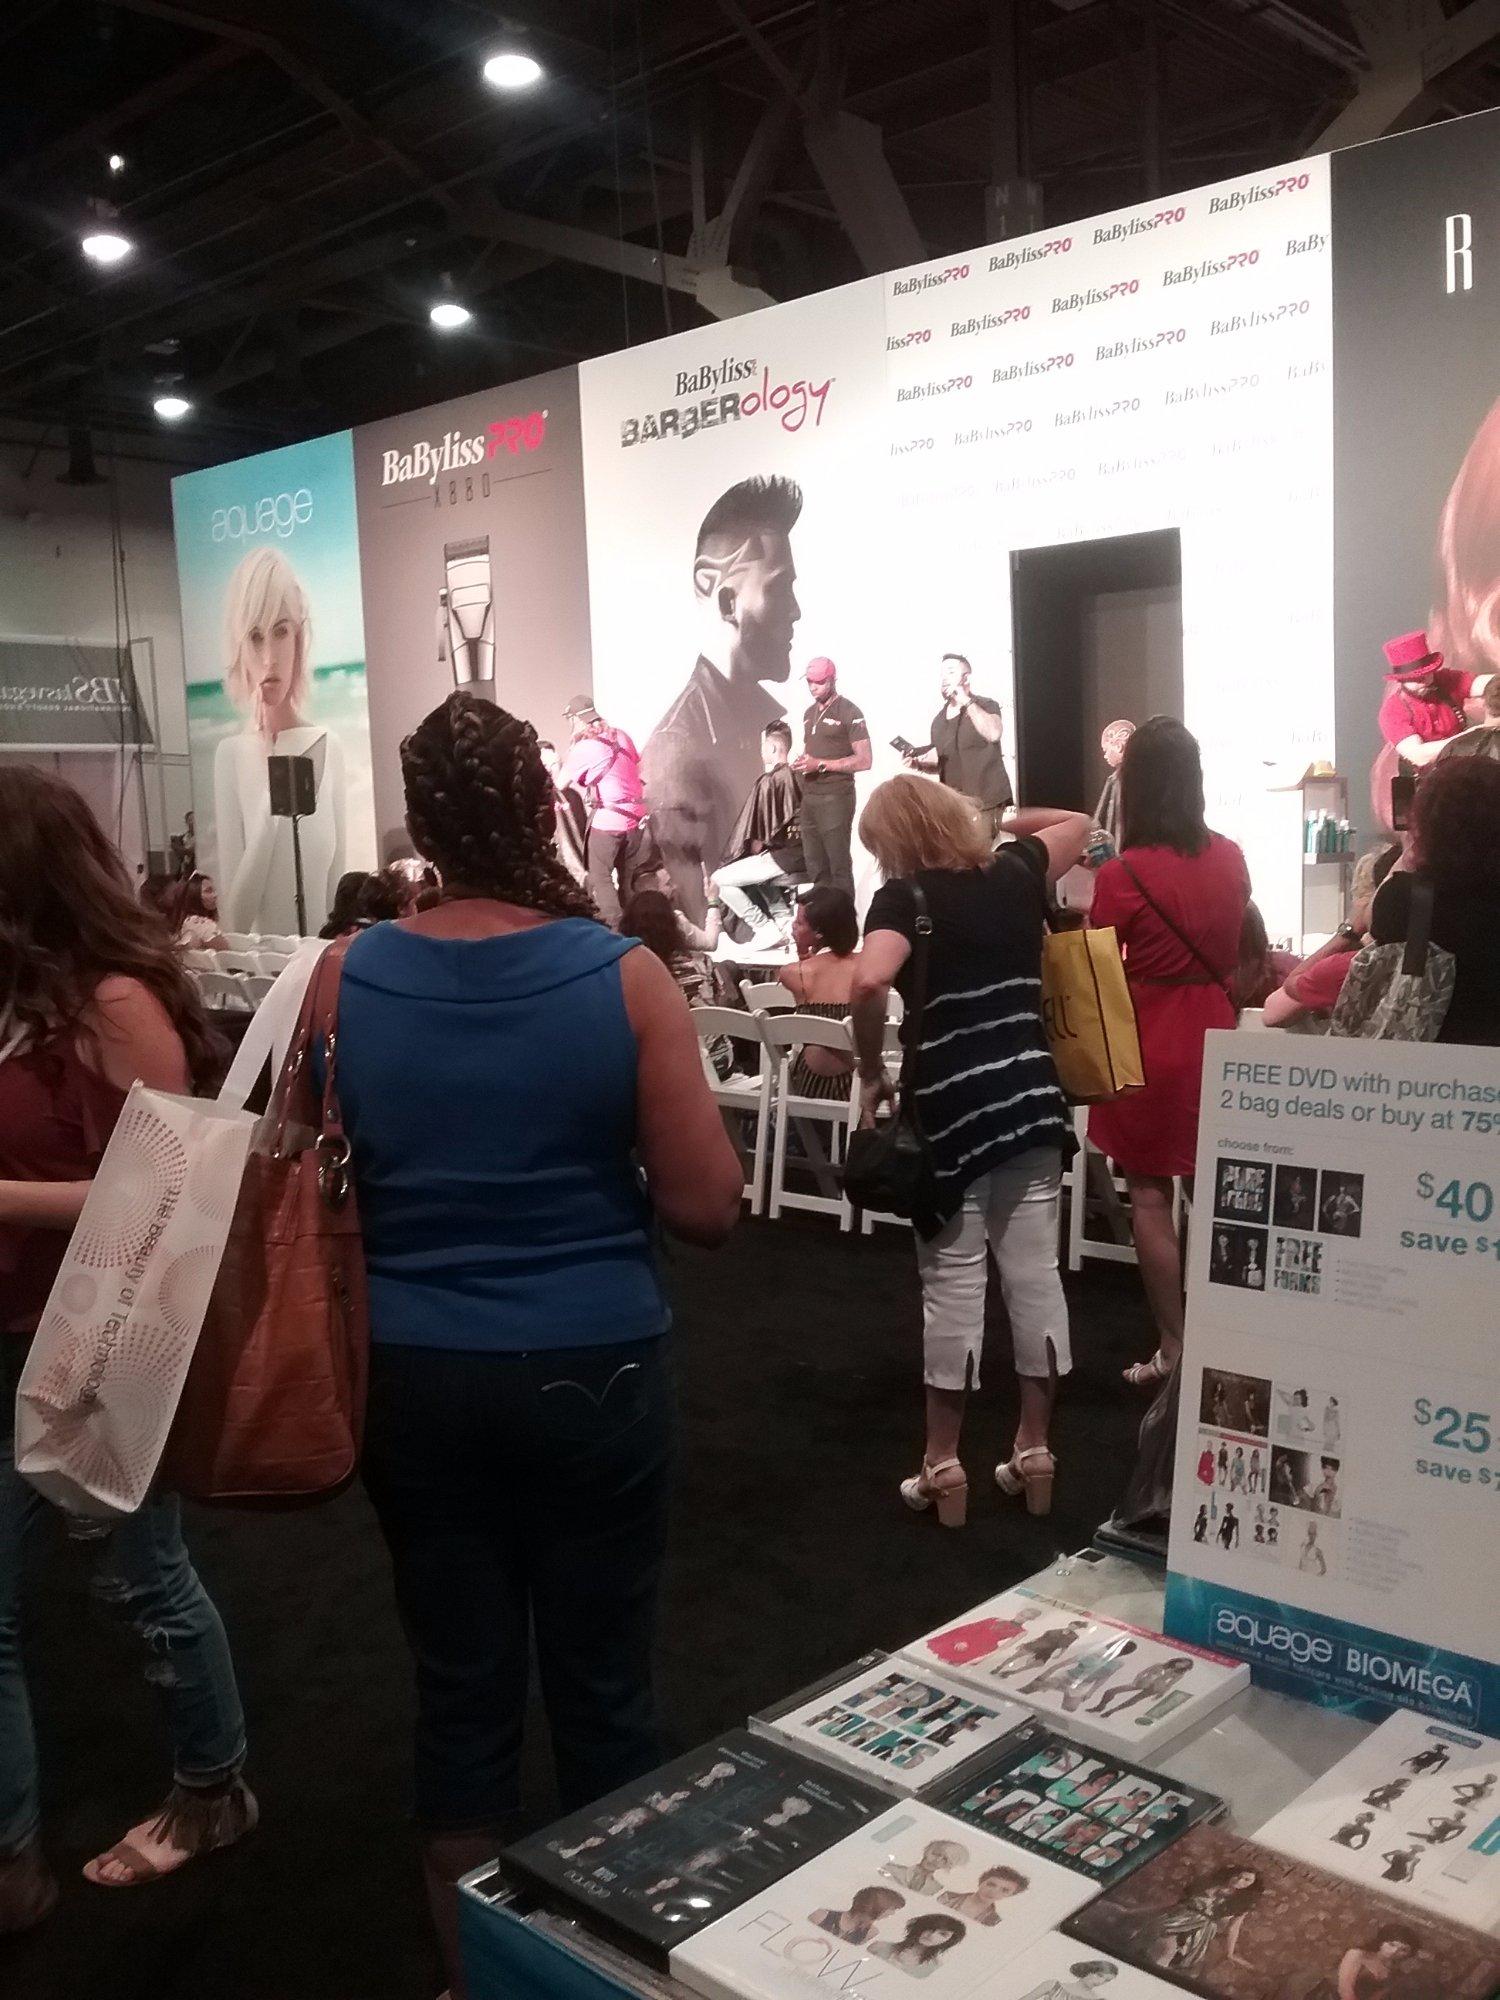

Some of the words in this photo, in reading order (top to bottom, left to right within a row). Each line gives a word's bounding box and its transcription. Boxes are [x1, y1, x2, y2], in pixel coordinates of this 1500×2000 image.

[893, 265, 970, 296] BaBylissPRO
[988, 237, 1074, 272] BaBylissPRO
[1092, 206, 1187, 246] BaBylissPRO
[1208, 173, 1310, 214] BaBylissPRO
[1446, 213, 1473, 294] R
[950, 305, 1031, 337] BaBylissPRO
[1051, 279, 1140, 313] BaBylissPRO
[1162, 249, 1260, 287] BaBylissPRO
[211, 488, 314, 543] aquage
[1223, 1062, 1282, 1085] FREE
[1289, 1066, 1337, 1089] DVD
[1344, 1072, 1390, 1094] with
[1397, 1079, 1500, 1102] purchas
[1220, 1089, 1234, 1109] 2
[1239, 1091, 1280, 1119] bag
[1285, 1095, 1344, 1120] deals
[1351, 1105, 1376, 1122] or
[1382, 1103, 1425, 1132] buy
[1431, 1110, 1454, 1130] at
[1417, 1171, 1494, 1223] $40
[1400, 1230, 1468, 1255] save
[1414, 1398, 1491, 1453] $25
[1416, 1459, 1471, 1484] save
[1217, 1608, 1332, 1663] aquage
[1346, 1648, 1474, 1709] BIOMEGA
